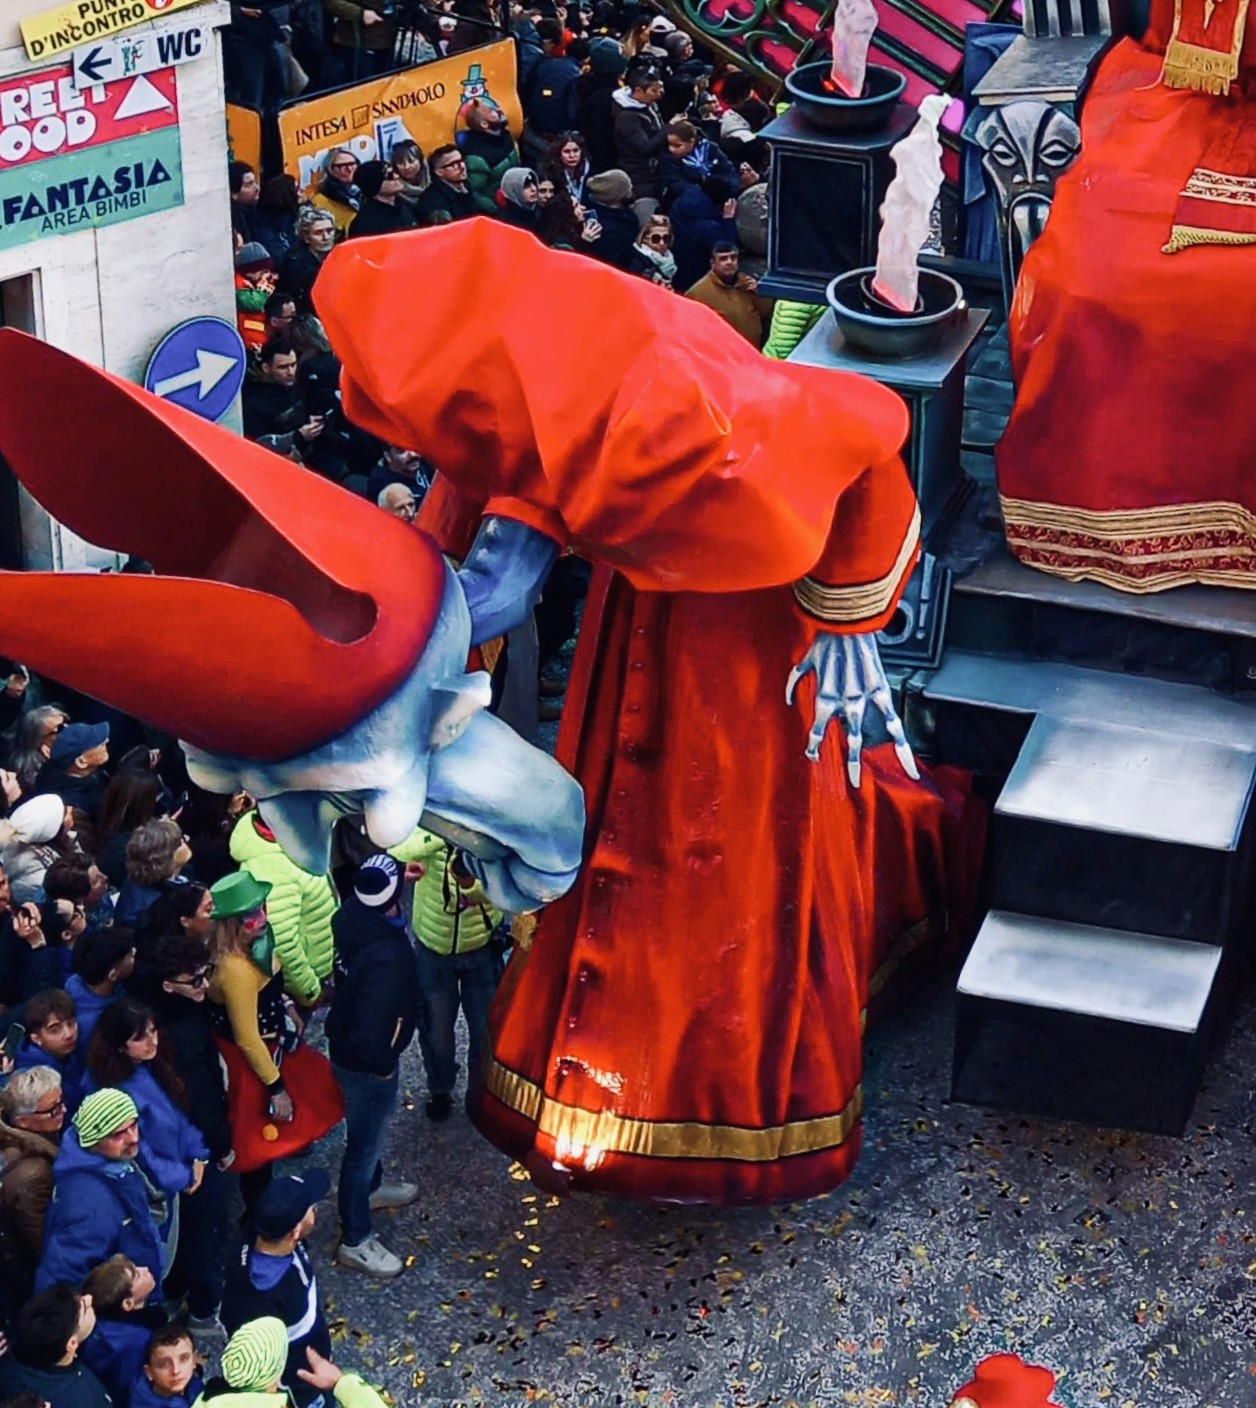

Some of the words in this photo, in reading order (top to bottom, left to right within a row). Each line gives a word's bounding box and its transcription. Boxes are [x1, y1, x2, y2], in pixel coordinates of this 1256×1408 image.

[30, 3, 145, 57] D'INCONTRO
[157, 28, 202, 65] WC
[295, 115, 347, 146] INTESA
[372, 82, 445, 119] SANPAOLO
[3, 158, 172, 225] FANTASIA
[41, 207, 91, 233] AREA
[96, 189, 147, 217] BIMBI
